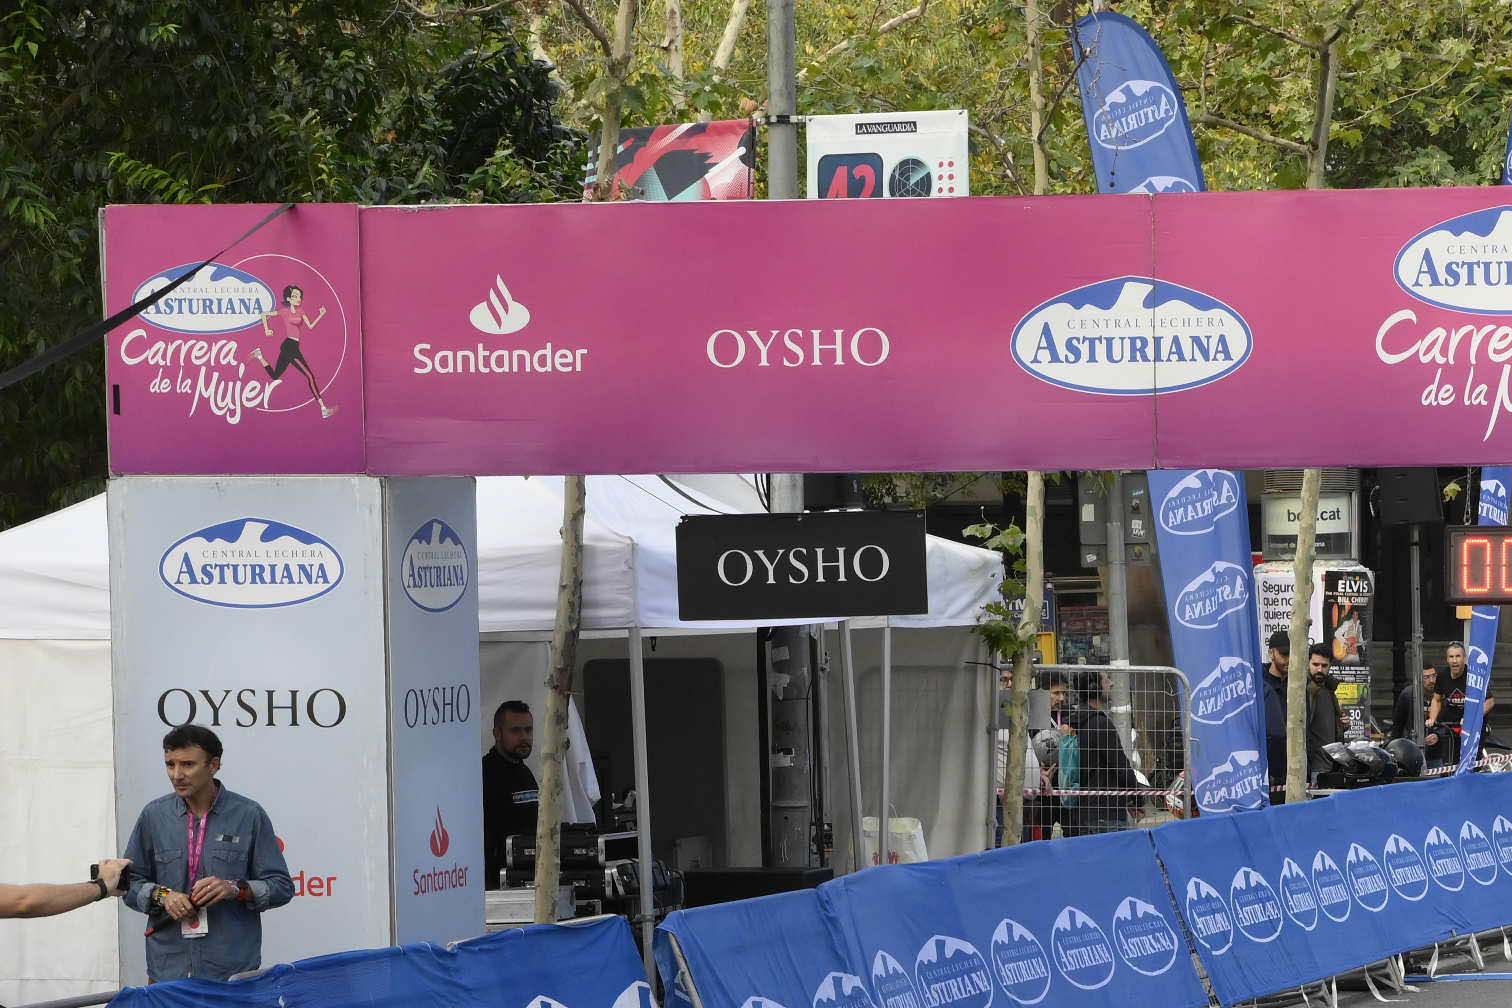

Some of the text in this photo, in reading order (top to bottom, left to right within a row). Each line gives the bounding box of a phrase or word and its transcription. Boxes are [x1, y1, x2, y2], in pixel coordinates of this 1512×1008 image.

[144, 289, 264, 315] ASTURIANA
[214, 286, 259, 294] LECHERA
[1066, 316, 1226, 329] CENTRAL LECHERA
[120, 328, 238, 367] Carrera
[412, 341, 588, 375] Santander
[706, 327, 891, 369] OYSHO
[1029, 320, 1235, 366] ASTURIANA
[150, 362, 283, 425] de la Mujer
[1421, 367, 1456, 407] de
[1463, 367, 1489, 407] la
[174, 551, 330, 586] ASTURIANA
[201, 548, 325, 560] CENTRAL LECHERA
[717, 545, 890, 586] OYSHO
[406, 554, 465, 590] ASTURIANA
[1338, 580, 1369, 593] ELVIS
[156, 687, 347, 728] OYSHO
[403, 683, 471, 729] OYSHO
[1349, 709, 1361, 720] 30
[412, 864, 469, 896] Santander
